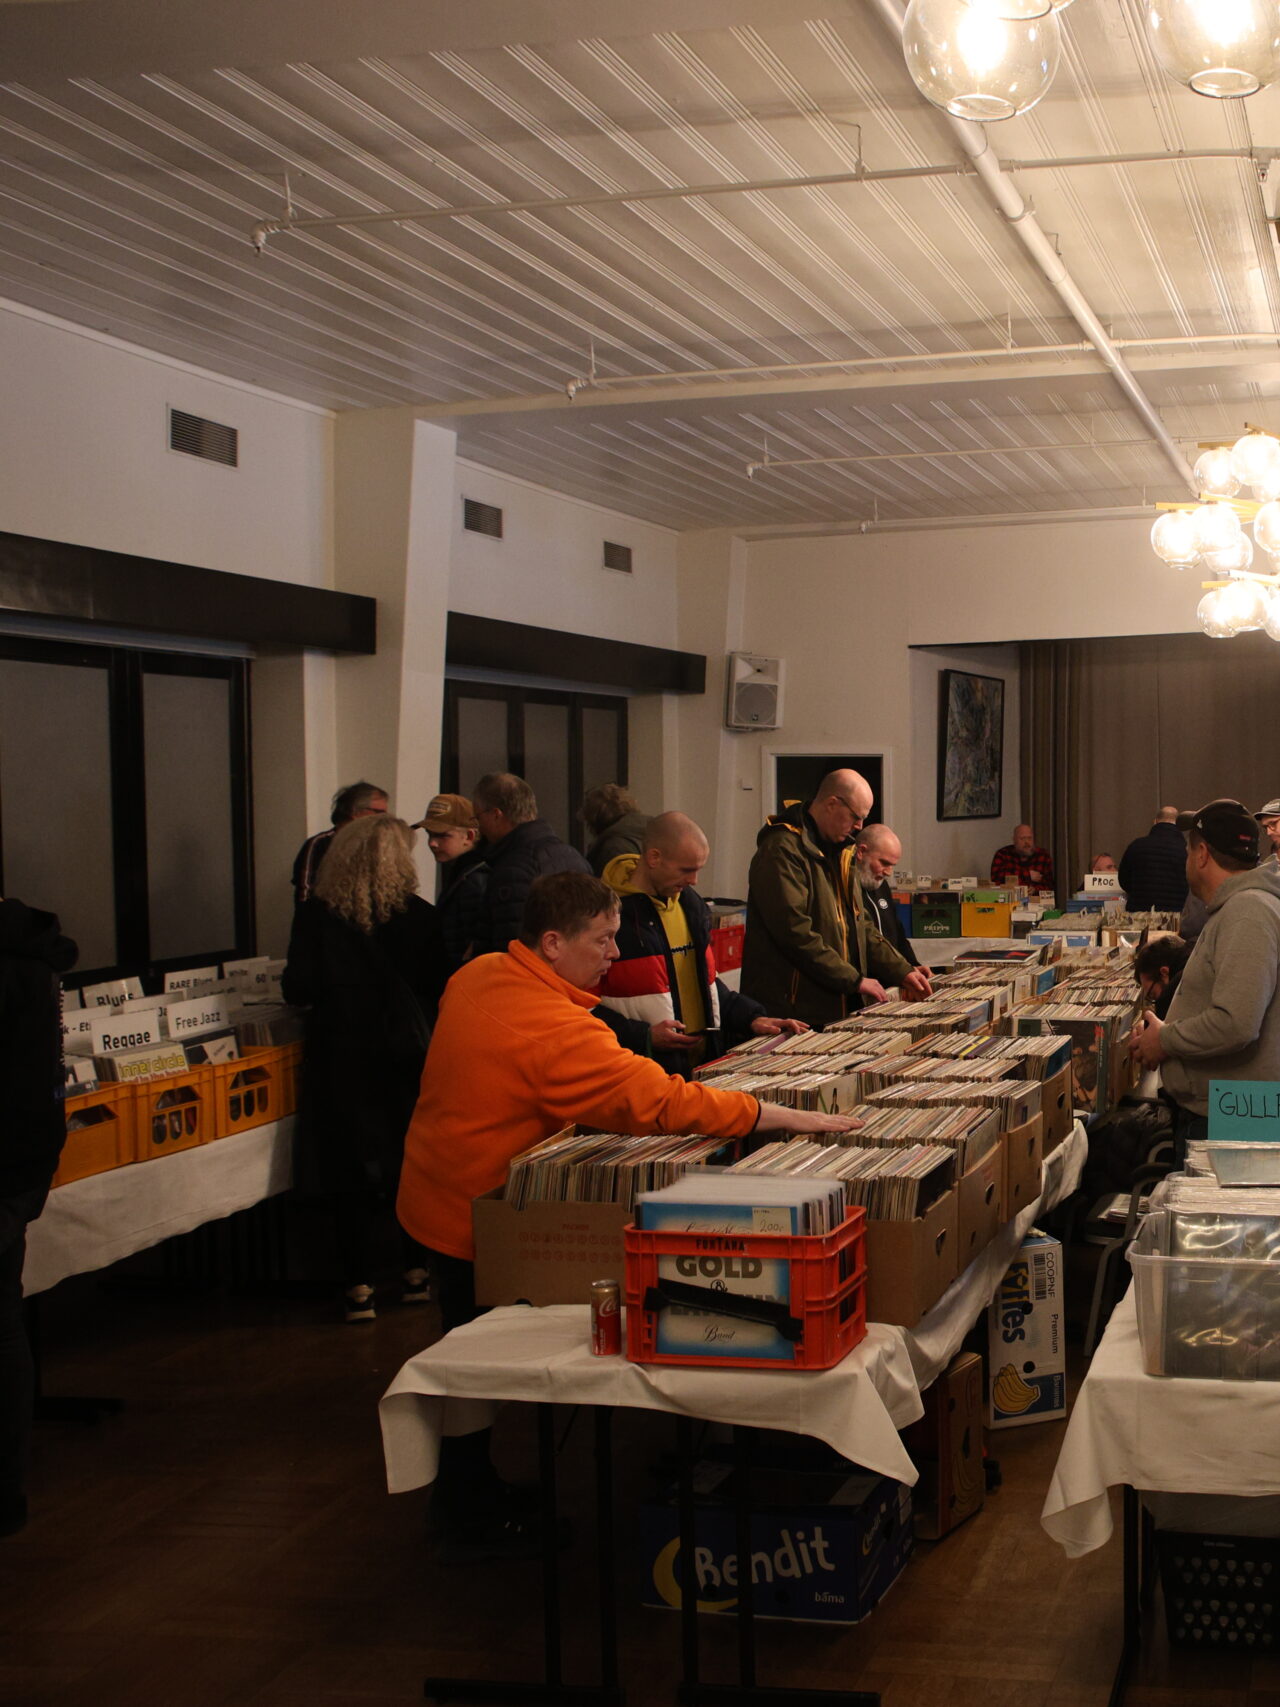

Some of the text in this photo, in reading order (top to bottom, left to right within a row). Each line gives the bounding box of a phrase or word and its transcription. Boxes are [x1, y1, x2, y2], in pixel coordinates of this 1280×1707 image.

[1092, 877, 1114, 886] PROG
[175, 1011, 220, 1030] Free Jazz
[675, 1255, 763, 1279] GOLD
[1051, 1313, 1059, 1354] Premium
